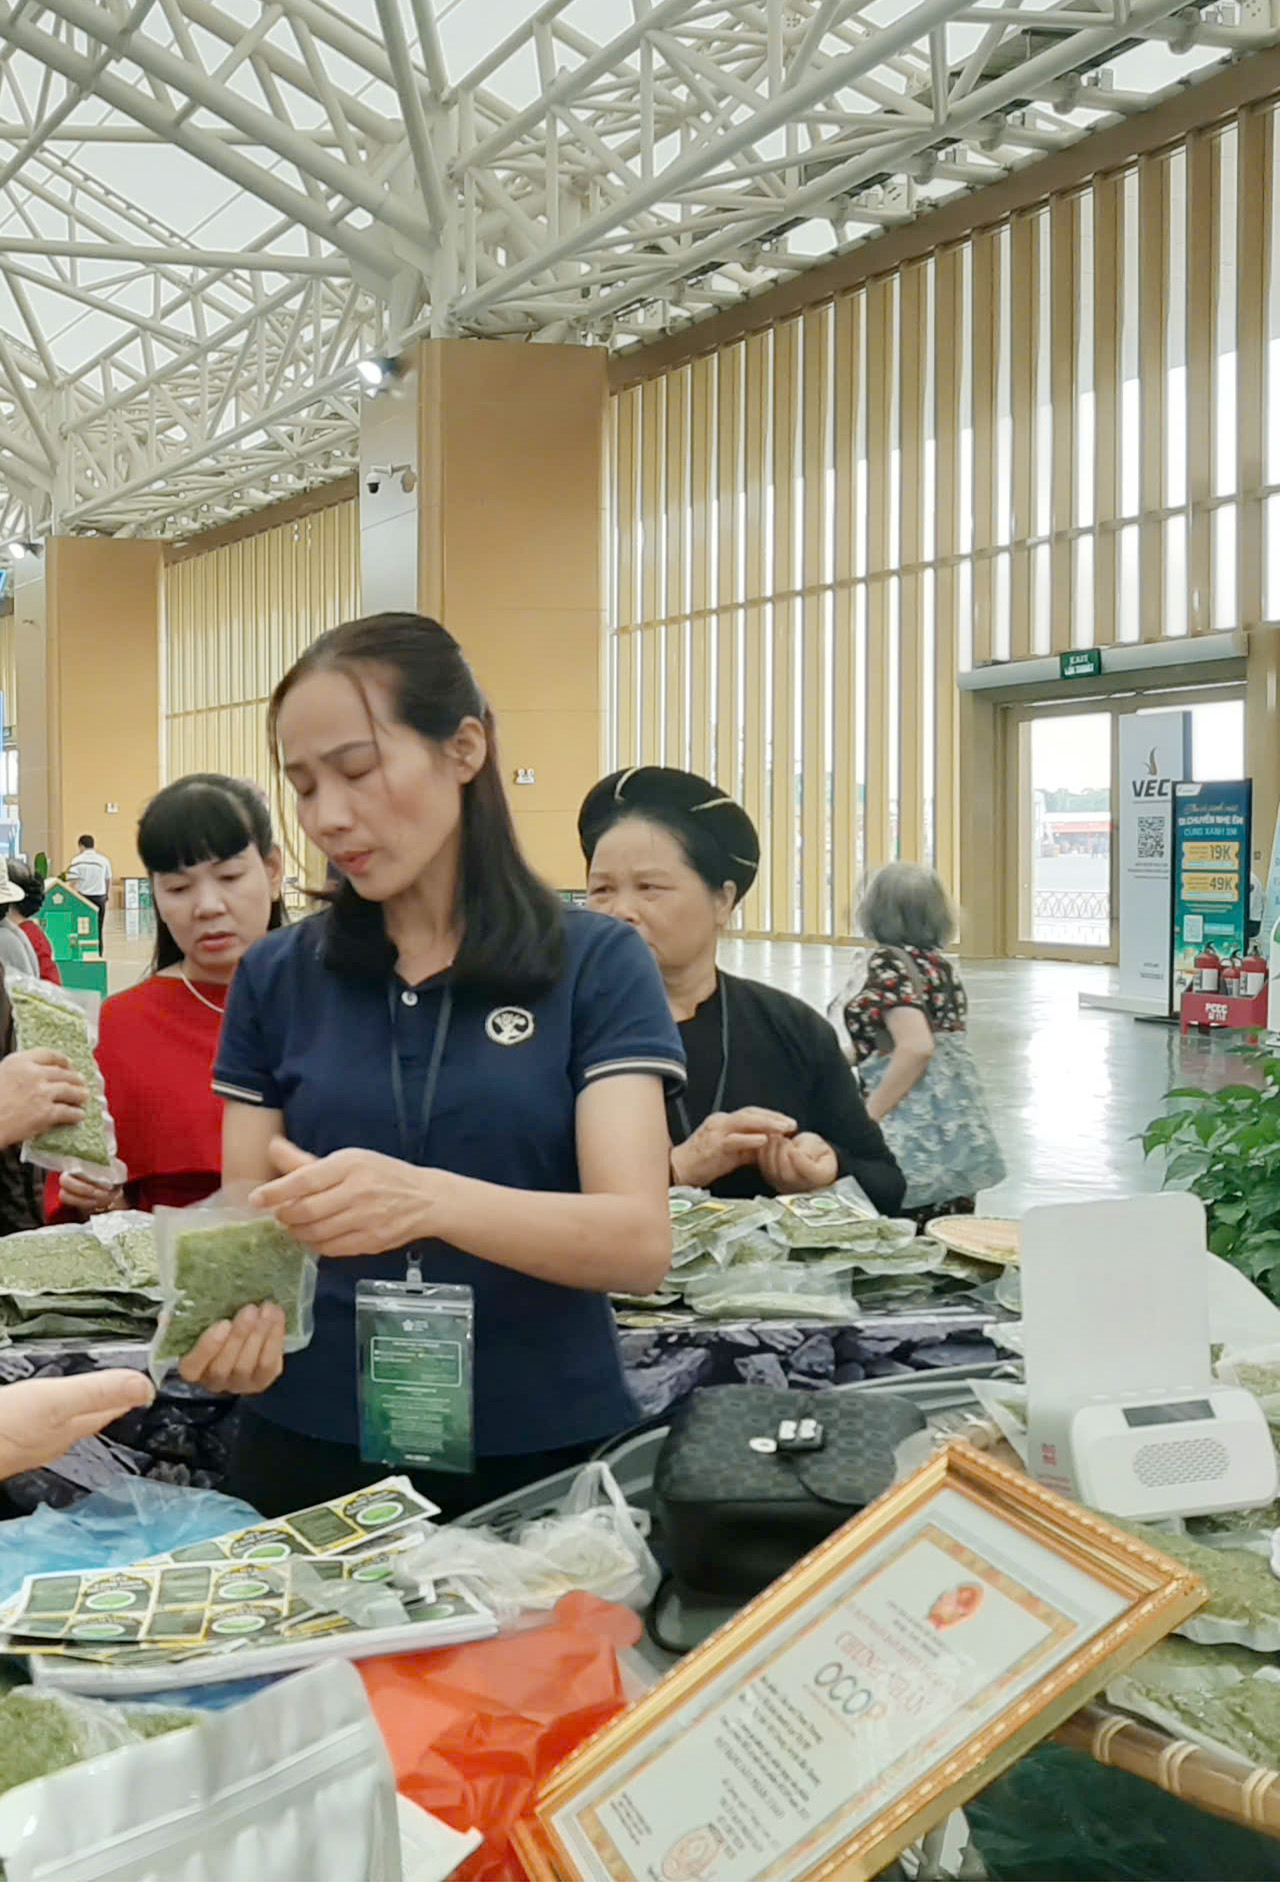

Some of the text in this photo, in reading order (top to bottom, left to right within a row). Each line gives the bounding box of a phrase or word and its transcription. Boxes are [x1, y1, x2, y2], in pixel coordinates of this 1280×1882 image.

[1132, 779, 1171, 798] VEC
[1209, 844, 1231, 860] 19K
[1209, 876, 1233, 891] 49K
